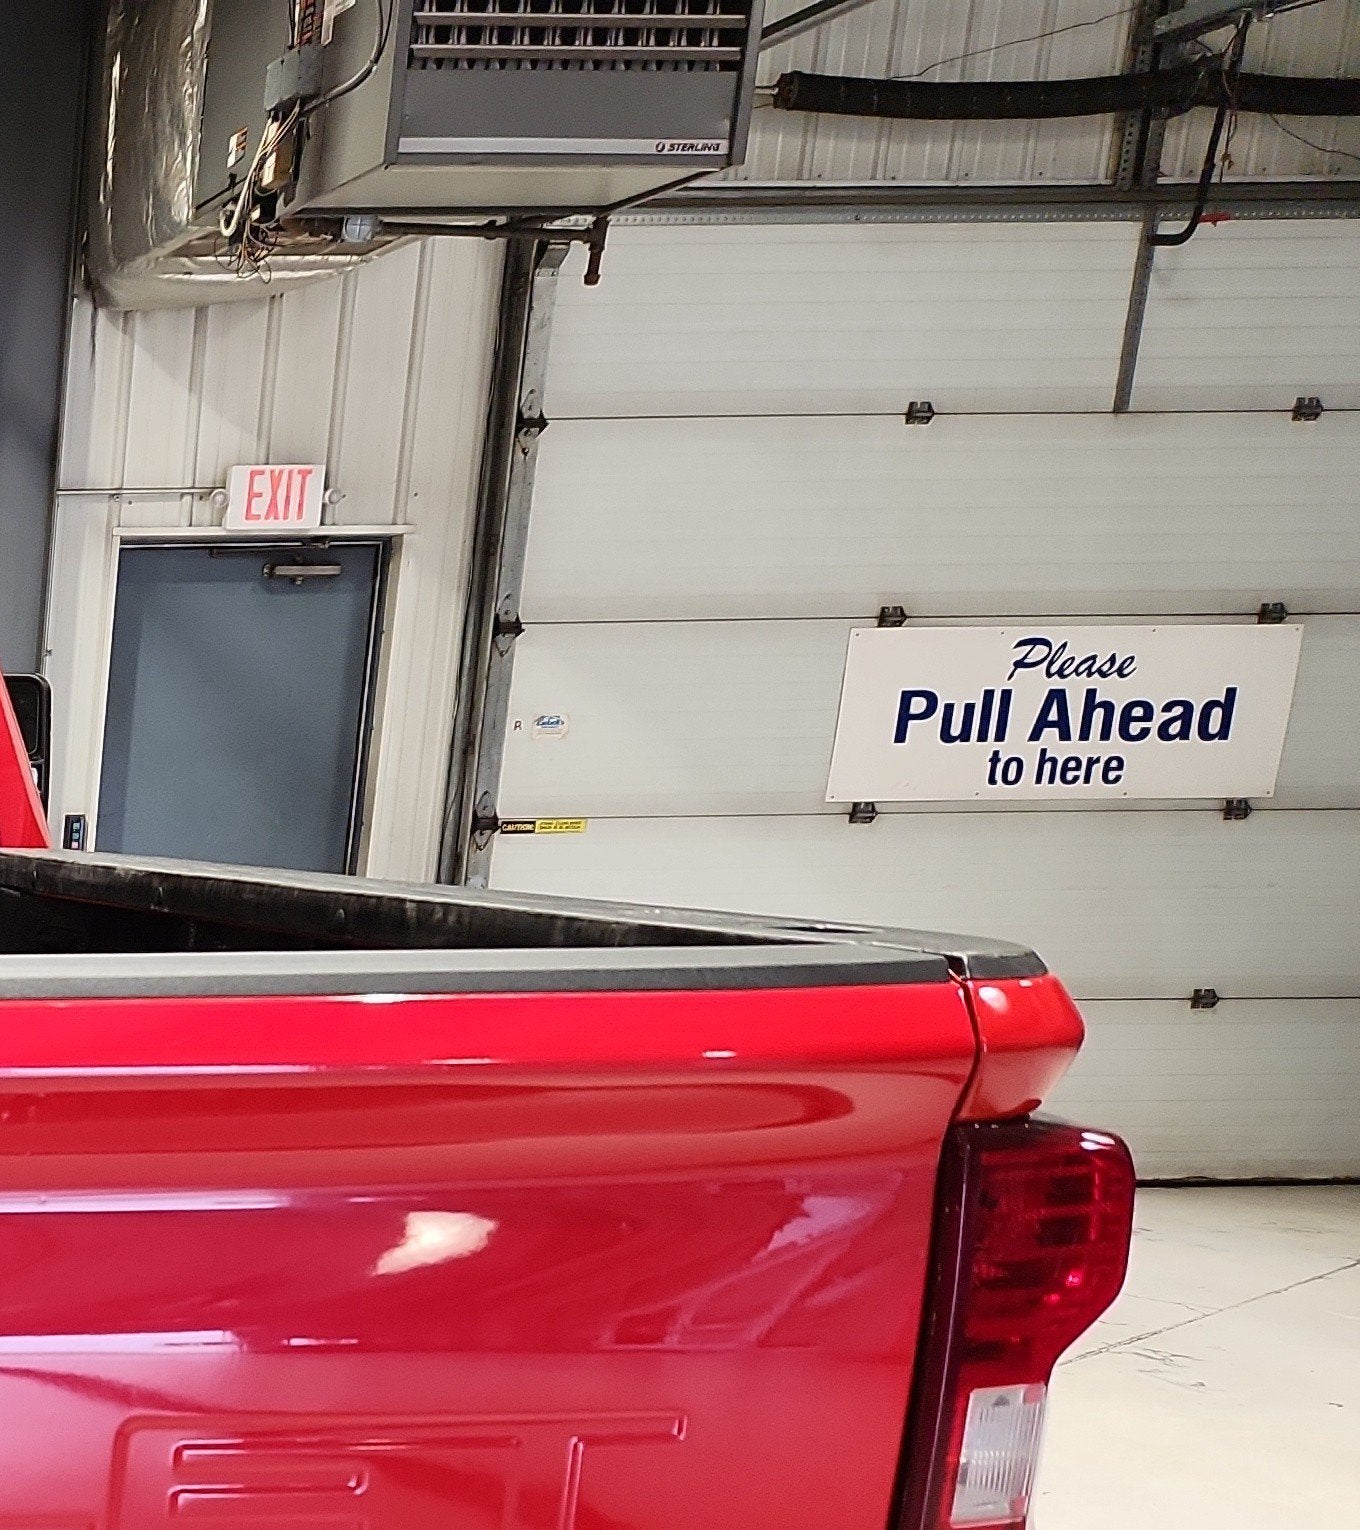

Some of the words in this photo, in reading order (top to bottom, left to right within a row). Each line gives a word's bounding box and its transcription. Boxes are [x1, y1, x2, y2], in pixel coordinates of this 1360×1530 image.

[667, 142, 721, 152] STERLING
[245, 468, 314, 521] EXIT
[1006, 637, 1137, 682] Please
[893, 689, 1012, 744] Pull
[1027, 686, 1238, 743] Ahead
[987, 749, 1024, 786] to
[1035, 747, 1125, 786] here
